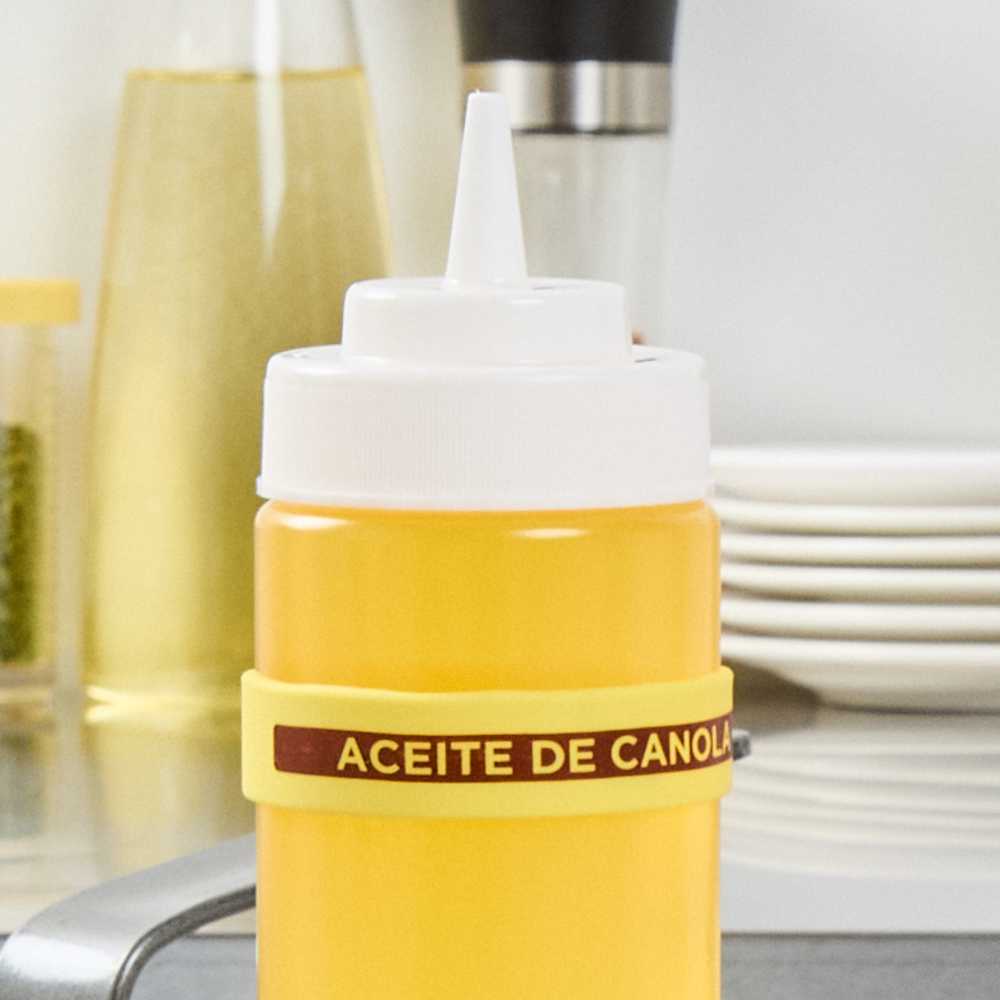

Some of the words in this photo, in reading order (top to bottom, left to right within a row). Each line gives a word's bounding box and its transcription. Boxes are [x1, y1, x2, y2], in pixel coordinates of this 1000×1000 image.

[336, 736, 513, 776] ACEITE
[531, 738, 597, 775] DE
[610, 719, 733, 771] CANOLA
